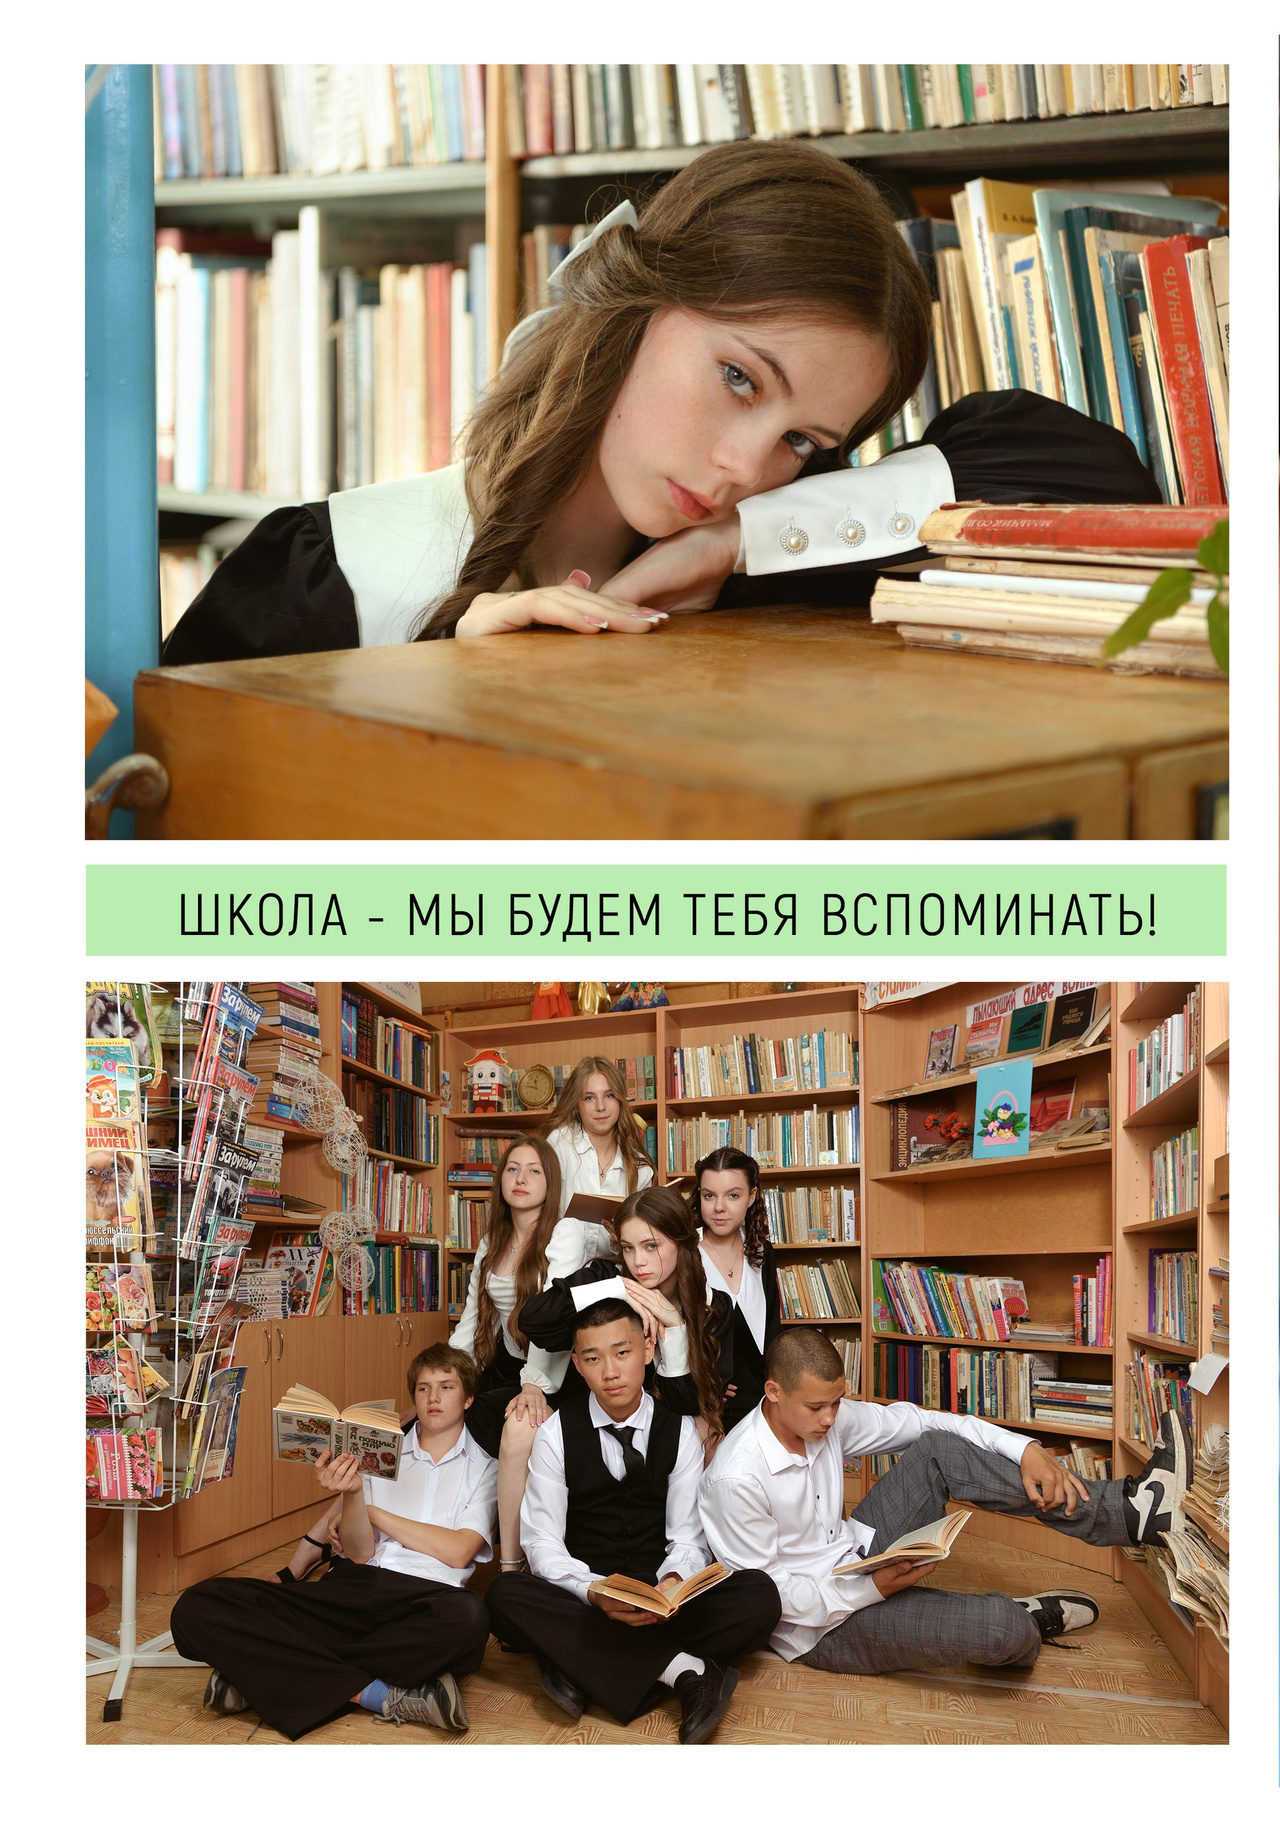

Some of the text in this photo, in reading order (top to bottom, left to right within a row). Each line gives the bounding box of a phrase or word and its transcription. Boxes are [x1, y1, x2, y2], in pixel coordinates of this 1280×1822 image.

[1162, 265, 1185, 336] ПЕЧАТЬ
[1174, 344, 1199, 428] ВОЕННАЯ
[898, 1103, 908, 1168] ЭНЦИКЛОПЕДИЯ
